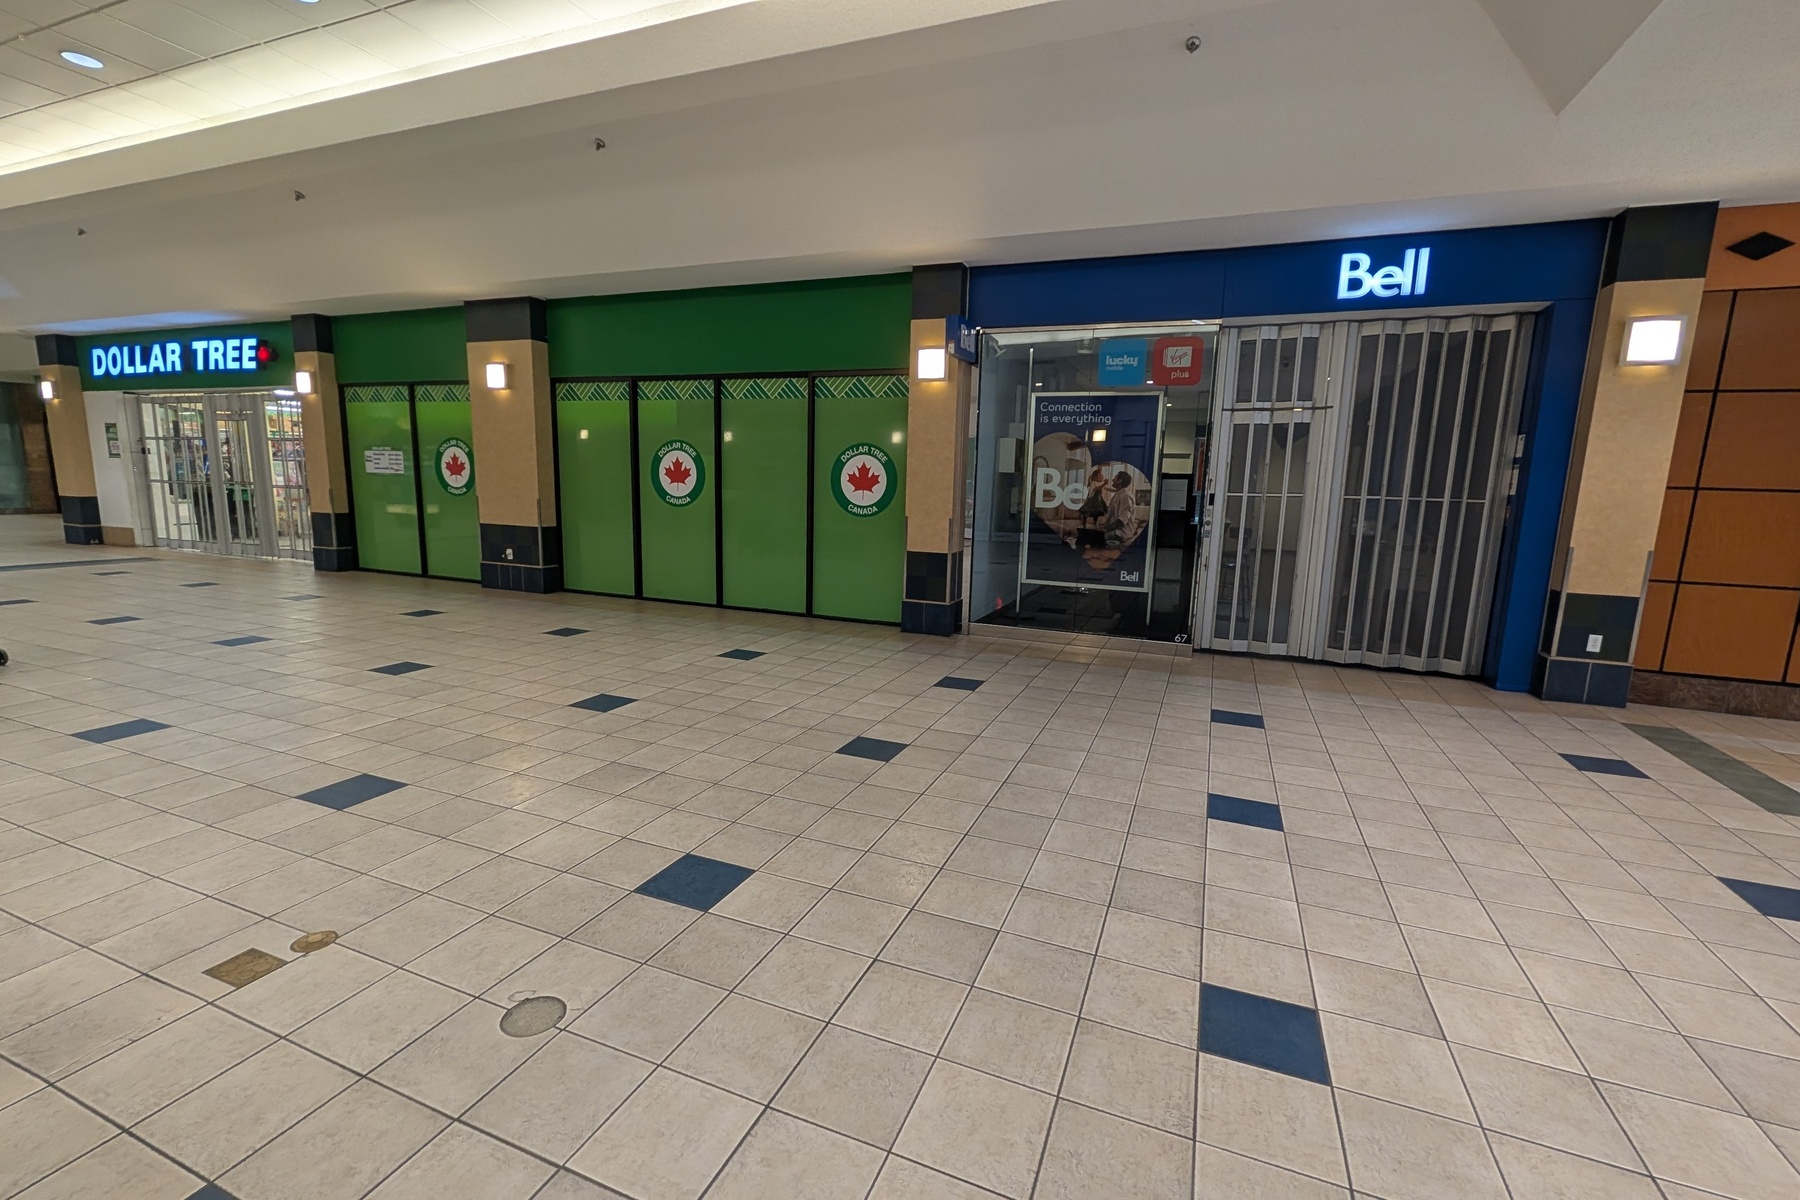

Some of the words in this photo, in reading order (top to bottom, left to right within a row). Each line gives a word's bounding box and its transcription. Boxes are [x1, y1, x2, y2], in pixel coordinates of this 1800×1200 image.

[1336, 247, 1431, 300] Bell
[91, 342, 182, 376] DOLLAR
[191, 338, 257, 371] TREE
[1105, 354, 1138, 367] lucky
[1170, 370, 1190, 380] plus
[1040, 402, 1102, 412] Connection
[1040, 413, 1049, 423] is
[1052, 413, 1112, 426] everything
[657, 442, 681, 458] DOLLAR
[681, 443, 698, 458] TREE
[840, 445, 869, 463] DOLLAR
[870, 446, 889, 464] TREE
[665, 495, 691, 505] CANADA
[847, 504, 879, 515] CANADA
[1120, 570, 1140, 582] Bell
[1174, 633, 1188, 643] 67
